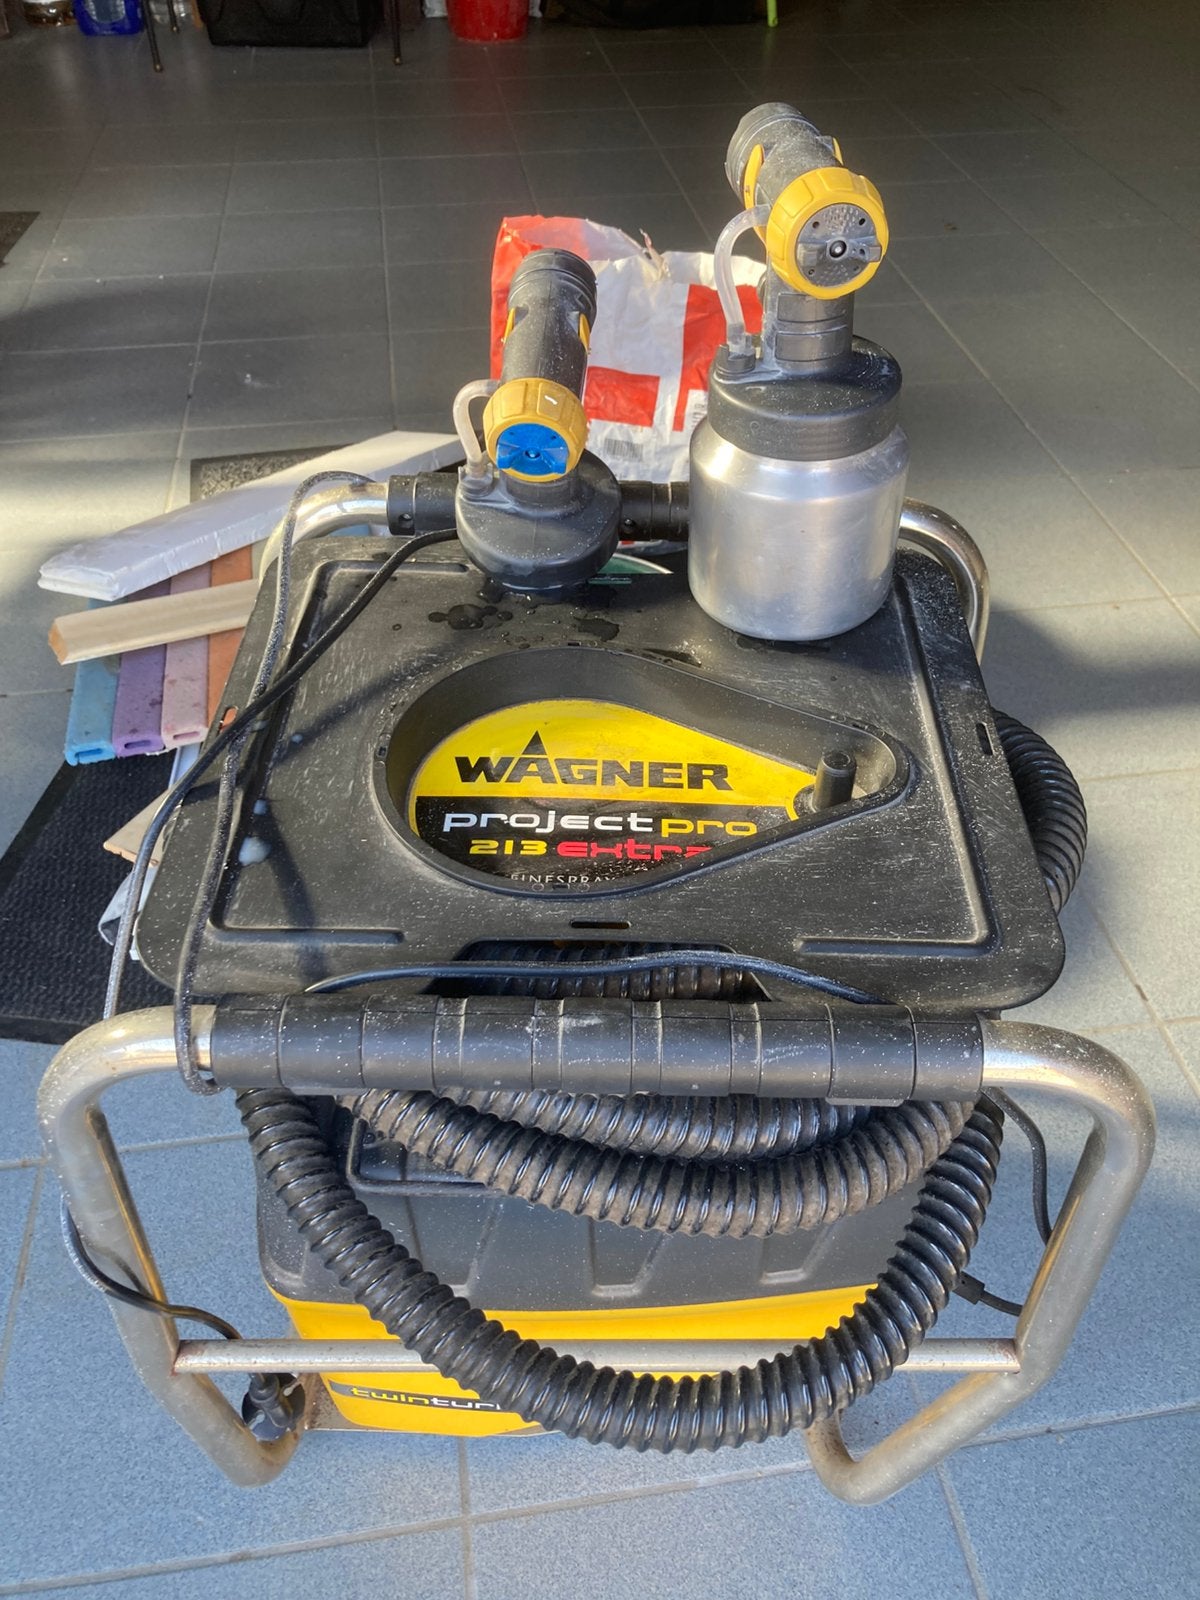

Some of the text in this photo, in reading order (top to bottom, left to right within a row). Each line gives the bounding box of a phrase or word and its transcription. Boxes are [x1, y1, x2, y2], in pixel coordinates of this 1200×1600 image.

[454, 730, 734, 791] WAGNER
[469, 839, 547, 855] 213
[350, 1386, 501, 1411] twintur
